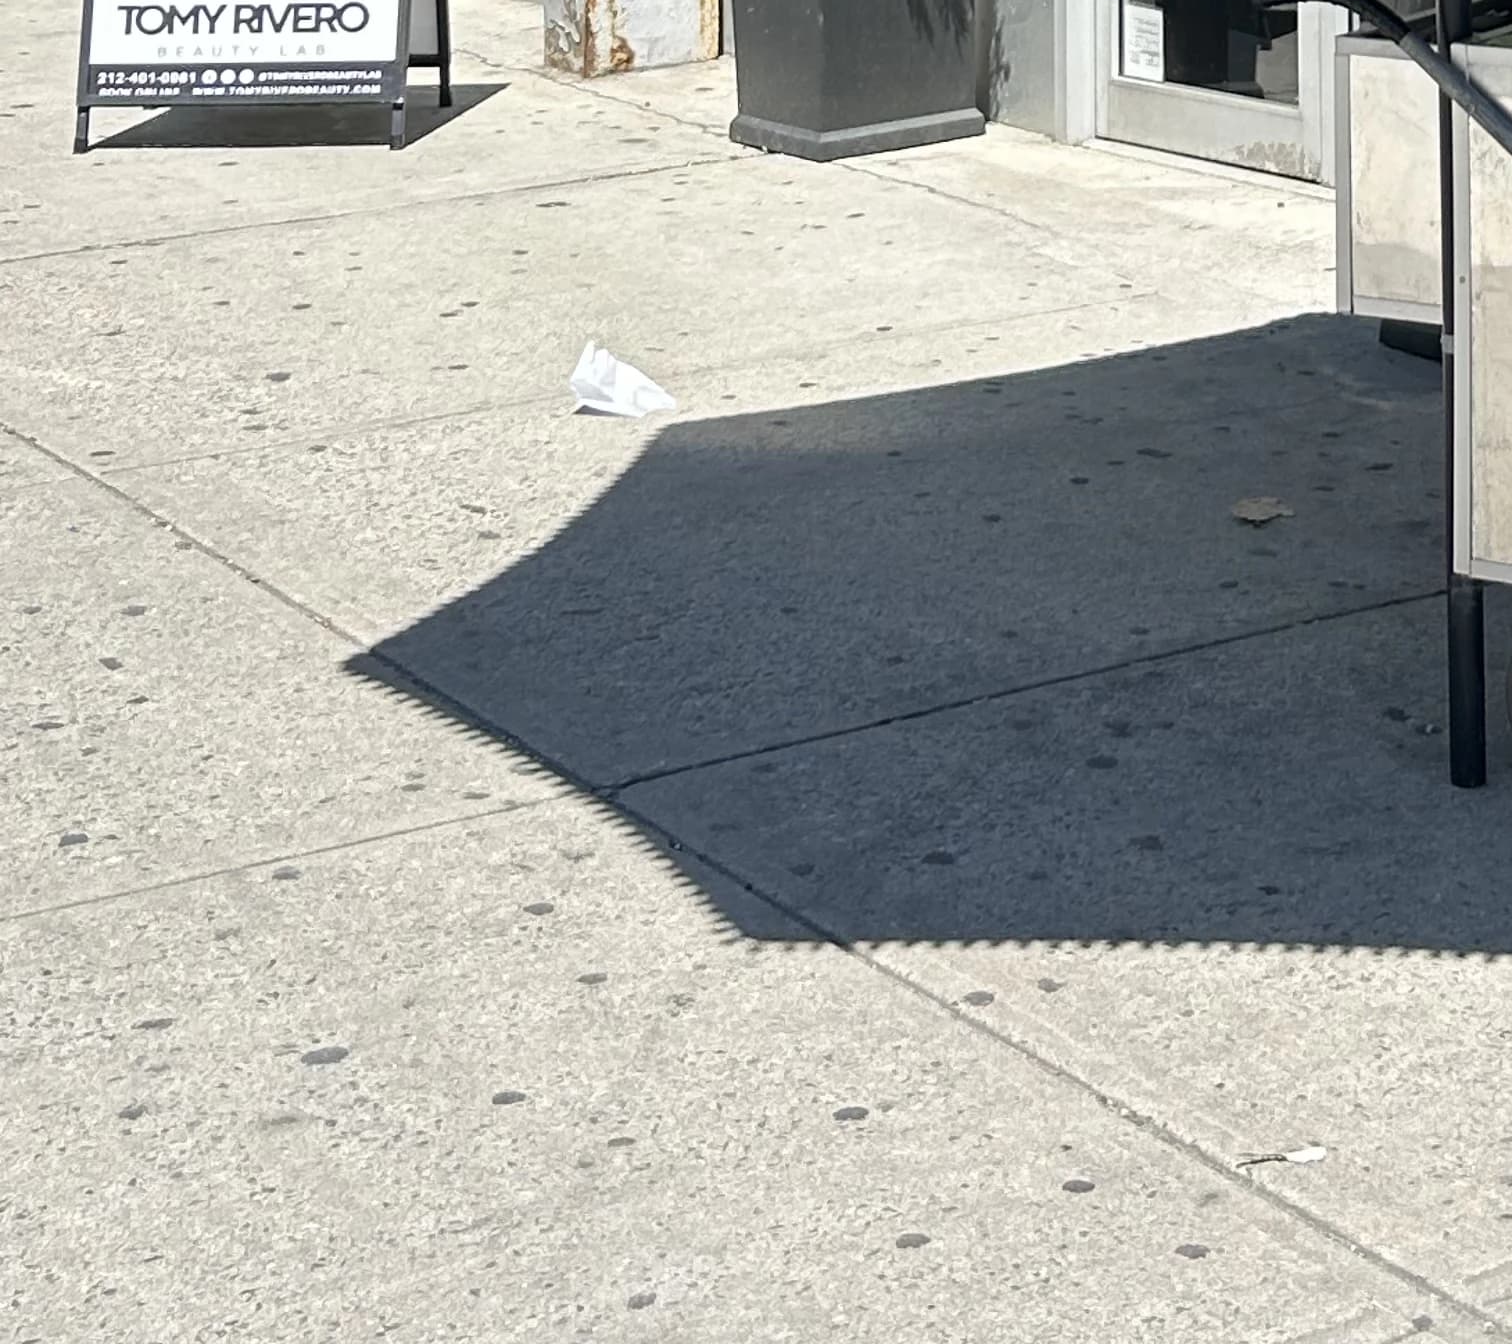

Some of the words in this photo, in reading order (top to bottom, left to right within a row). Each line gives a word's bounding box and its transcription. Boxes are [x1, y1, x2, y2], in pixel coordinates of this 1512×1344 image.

[117, 4, 228, 35] TOMY
[233, 2, 370, 34] RIVERO
[157, 45, 259, 58] BEAUTY
[280, 44, 326, 57] LAB
